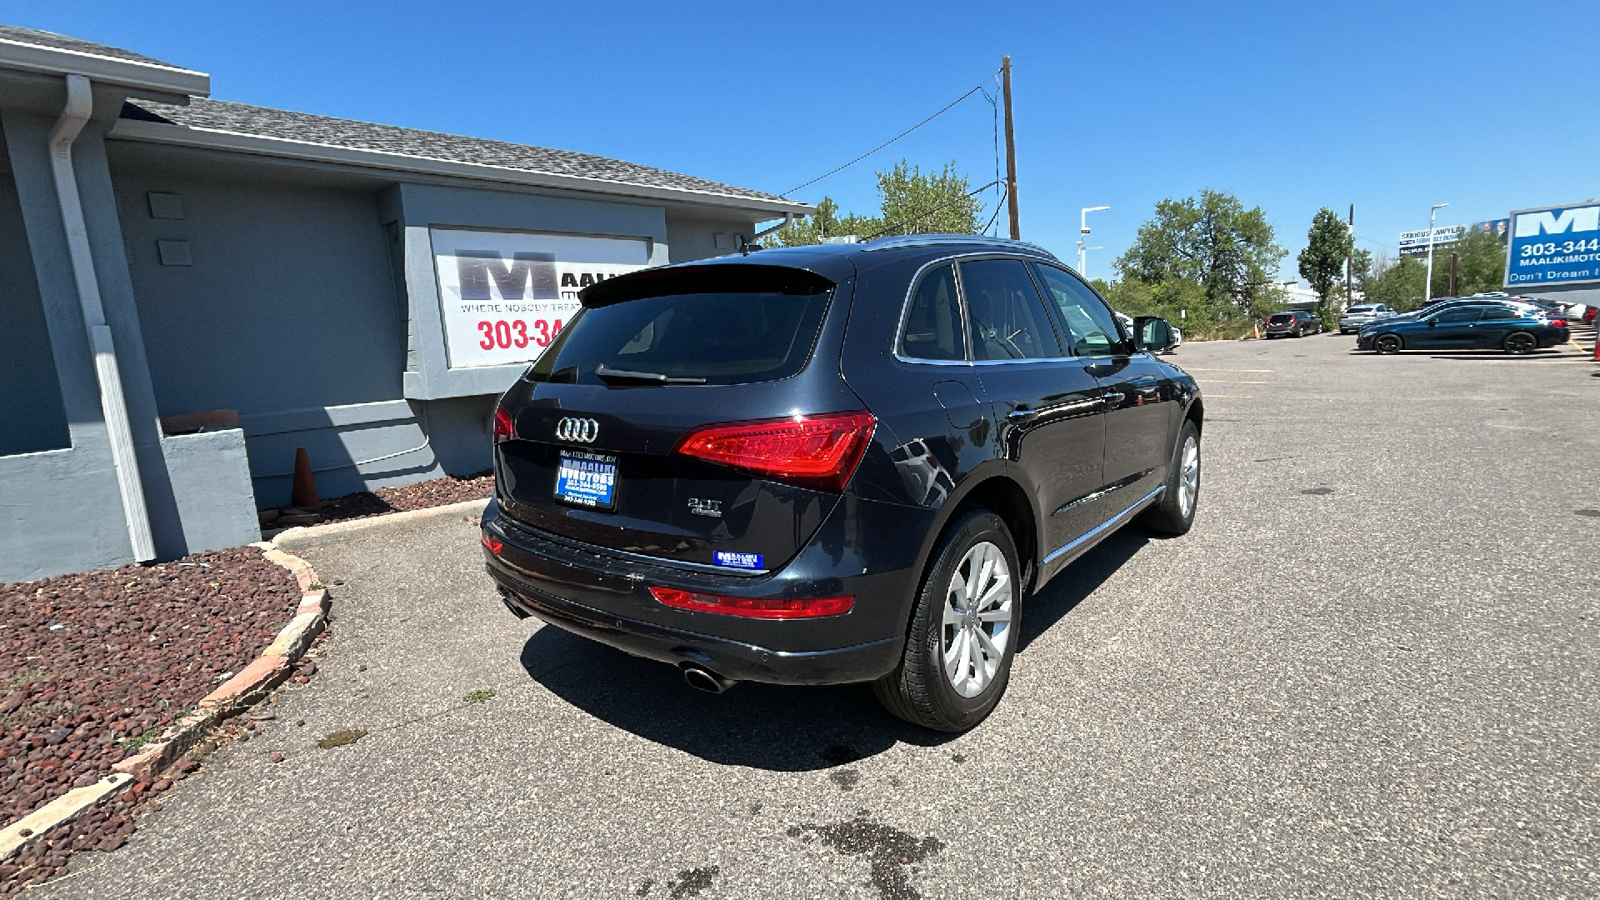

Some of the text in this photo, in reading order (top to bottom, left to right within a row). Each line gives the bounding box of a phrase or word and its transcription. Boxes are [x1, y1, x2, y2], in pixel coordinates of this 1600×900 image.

[1402, 231, 1430, 239] SERIOUS
[1521, 239, 1600, 257] 303-344
[1510, 272, 1543, 281] Don't
[1547, 268, 1589, 279] Dream
[461, 304, 501, 313] WHERE
[505, 304, 548, 313] NOBODY
